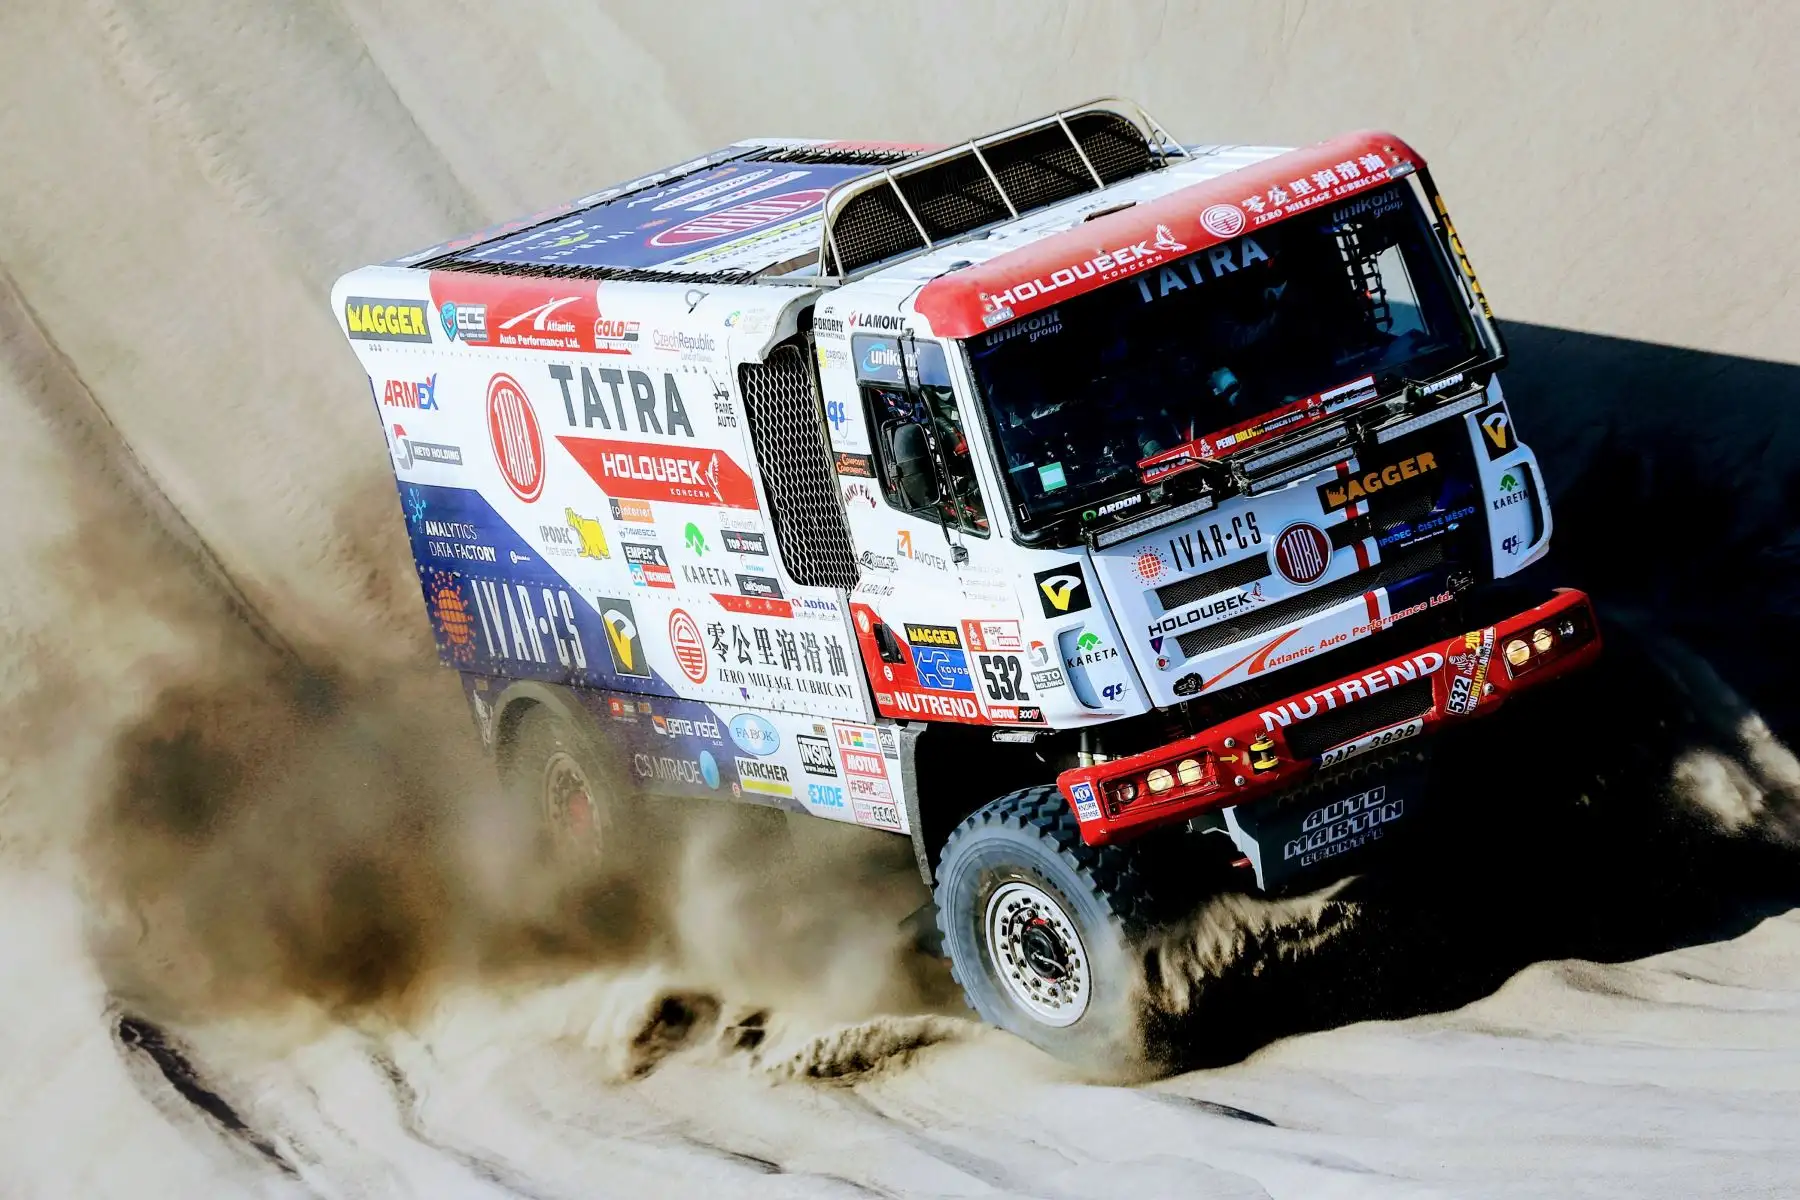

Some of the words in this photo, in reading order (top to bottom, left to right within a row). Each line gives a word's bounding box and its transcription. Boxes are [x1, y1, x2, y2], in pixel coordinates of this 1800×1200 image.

[1253, 209, 1283, 225] ZERO
[1285, 191, 1332, 213] MILEAGE
[1334, 170, 1390, 196] LUBRICANT
[991, 240, 1156, 310] HOLOUBEK
[1102, 254, 1163, 281] KONCERN
[1130, 237, 1268, 303] TATRA
[547, 321, 576, 333] Atlantic
[595, 319, 626, 338] GOLD
[857, 313, 906, 331] LAMONT
[985, 310, 1061, 346] unikont
[1029, 323, 1063, 343] group
[500, 335, 516, 346] Auto
[517, 335, 564, 348] Performance
[565, 338, 580, 350] Ltd.
[384, 373, 439, 411] ARMEX
[1423, 373, 1464, 397] ARDON
[548, 364, 695, 437] TATRA
[714, 402, 734, 415] PAME
[717, 416, 737, 429] AUTO
[1215, 433, 1236, 450] PERU
[432, 447, 461, 461] HOLDING
[601, 453, 706, 486] HOLOUBEK
[670, 488, 710, 499] KONCERN
[1098, 493, 1142, 517] ARDON
[1492, 488, 1530, 511] KARETA
[426, 520, 477, 540] ANALYTICS
[540, 525, 573, 544] IPODEC
[1378, 528, 1412, 548] IPODEC
[429, 541, 452, 557] DATA
[454, 546, 497, 563] FACTORY
[914, 549, 949, 572] AVOTEX
[1281, 528, 1323, 579] TATRA
[681, 564, 732, 588] KARETA
[803, 599, 838, 611] ADRIA
[1148, 591, 1253, 637] HOLOUBEK
[1216, 604, 1256, 622] KONCERN
[1268, 645, 1316, 669] Atlantic
[1319, 631, 1348, 649] Auto
[1352, 600, 1428, 637] Performance
[1429, 591, 1455, 607] Ltd.
[707, 621, 850, 677] 零公里润滑油
[1066, 647, 1119, 669] KARETA
[1464, 653, 1477, 675] DAKAR
[717, 668, 745, 684] ZERO
[748, 672, 794, 691] MILEAGE
[796, 679, 853, 699] LUBRICANT
[979, 655, 1030, 701] 532
[1032, 670, 1061, 683] NETO
[1035, 680, 1064, 690] HOLDING
[1471, 664, 1488, 697] BOLIVIA
[1259, 652, 1444, 732] NUTREND
[1449, 678, 1471, 712] 532
[894, 691, 978, 719] NUTREND
[990, 709, 1017, 720] MOTUL
[1019, 709, 1040, 720] 300V
[736, 728, 775, 743] FABOK
[1369, 724, 1417, 749] 3838
[846, 754, 881, 774] MOTUL
[808, 783, 844, 808] EXIDE
[1077, 801, 1097, 812] KNORR
[1302, 785, 1386, 833] AUTO
[1284, 800, 1404, 861] MARTIN
